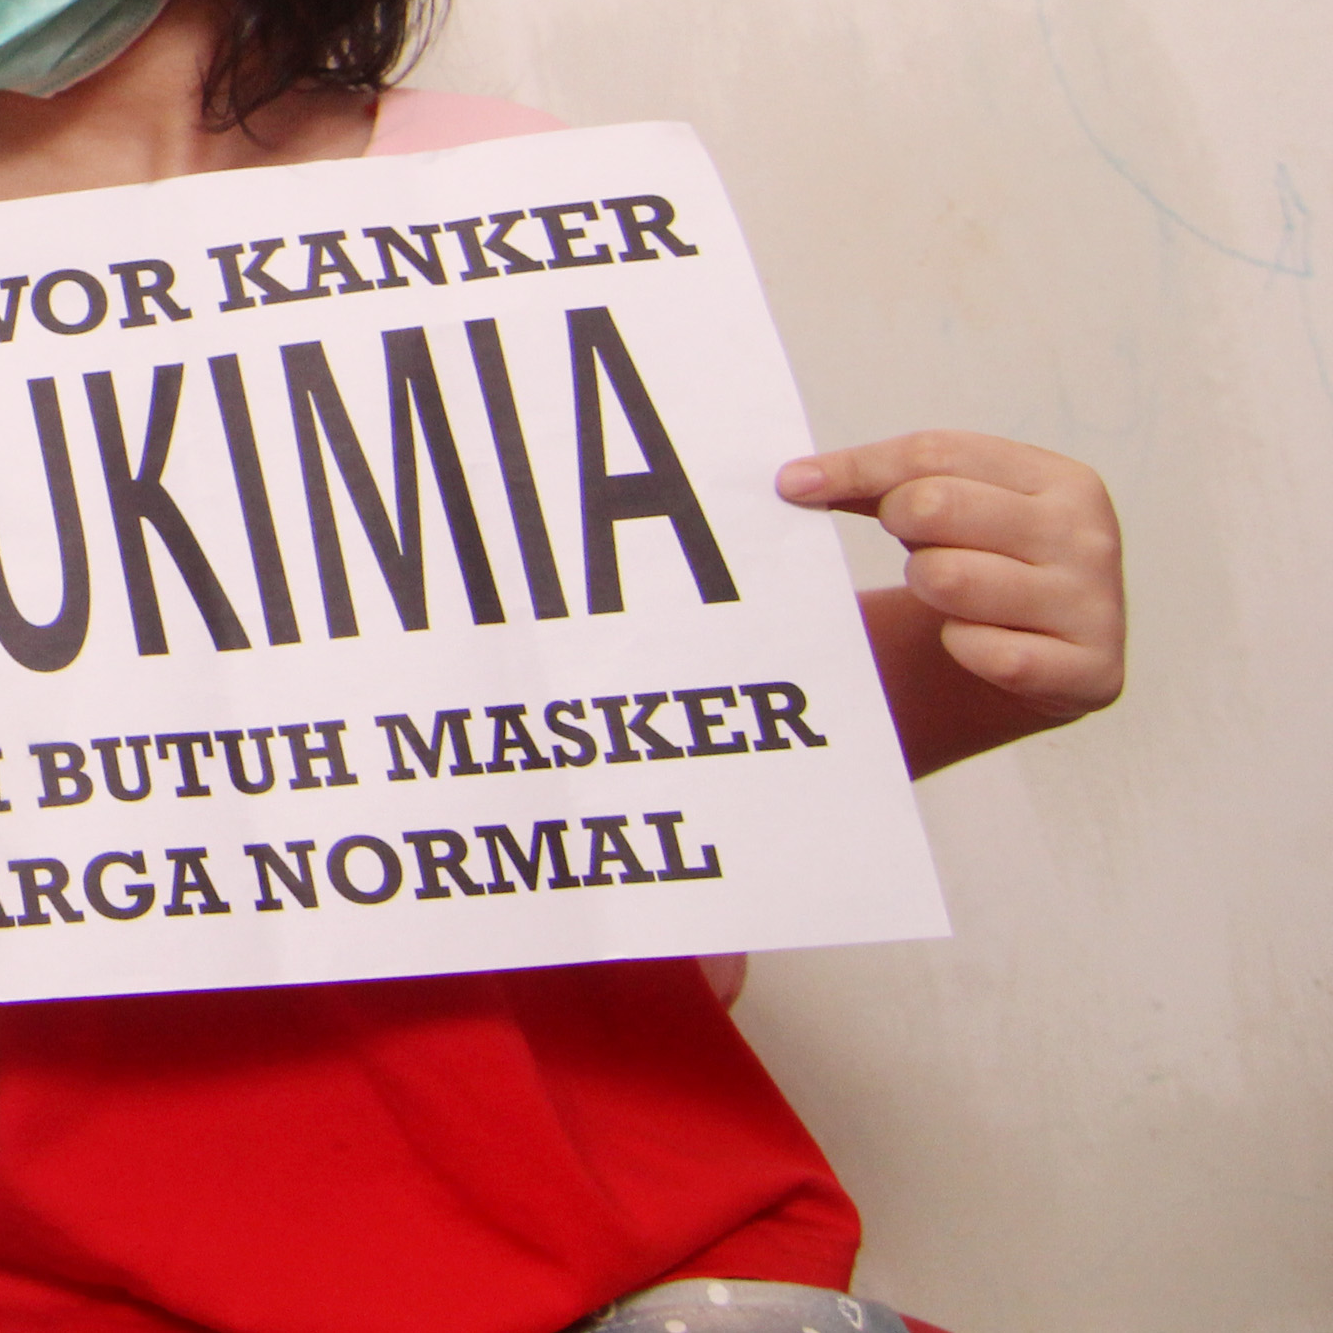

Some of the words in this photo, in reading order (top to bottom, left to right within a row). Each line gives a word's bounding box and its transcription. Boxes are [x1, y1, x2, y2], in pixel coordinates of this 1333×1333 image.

[207, 195, 698, 312] KANKER
[29, 720, 358, 808] BUTUH
[375, 681, 828, 781] MASKER
[244, 811, 723, 912] NORMAL
